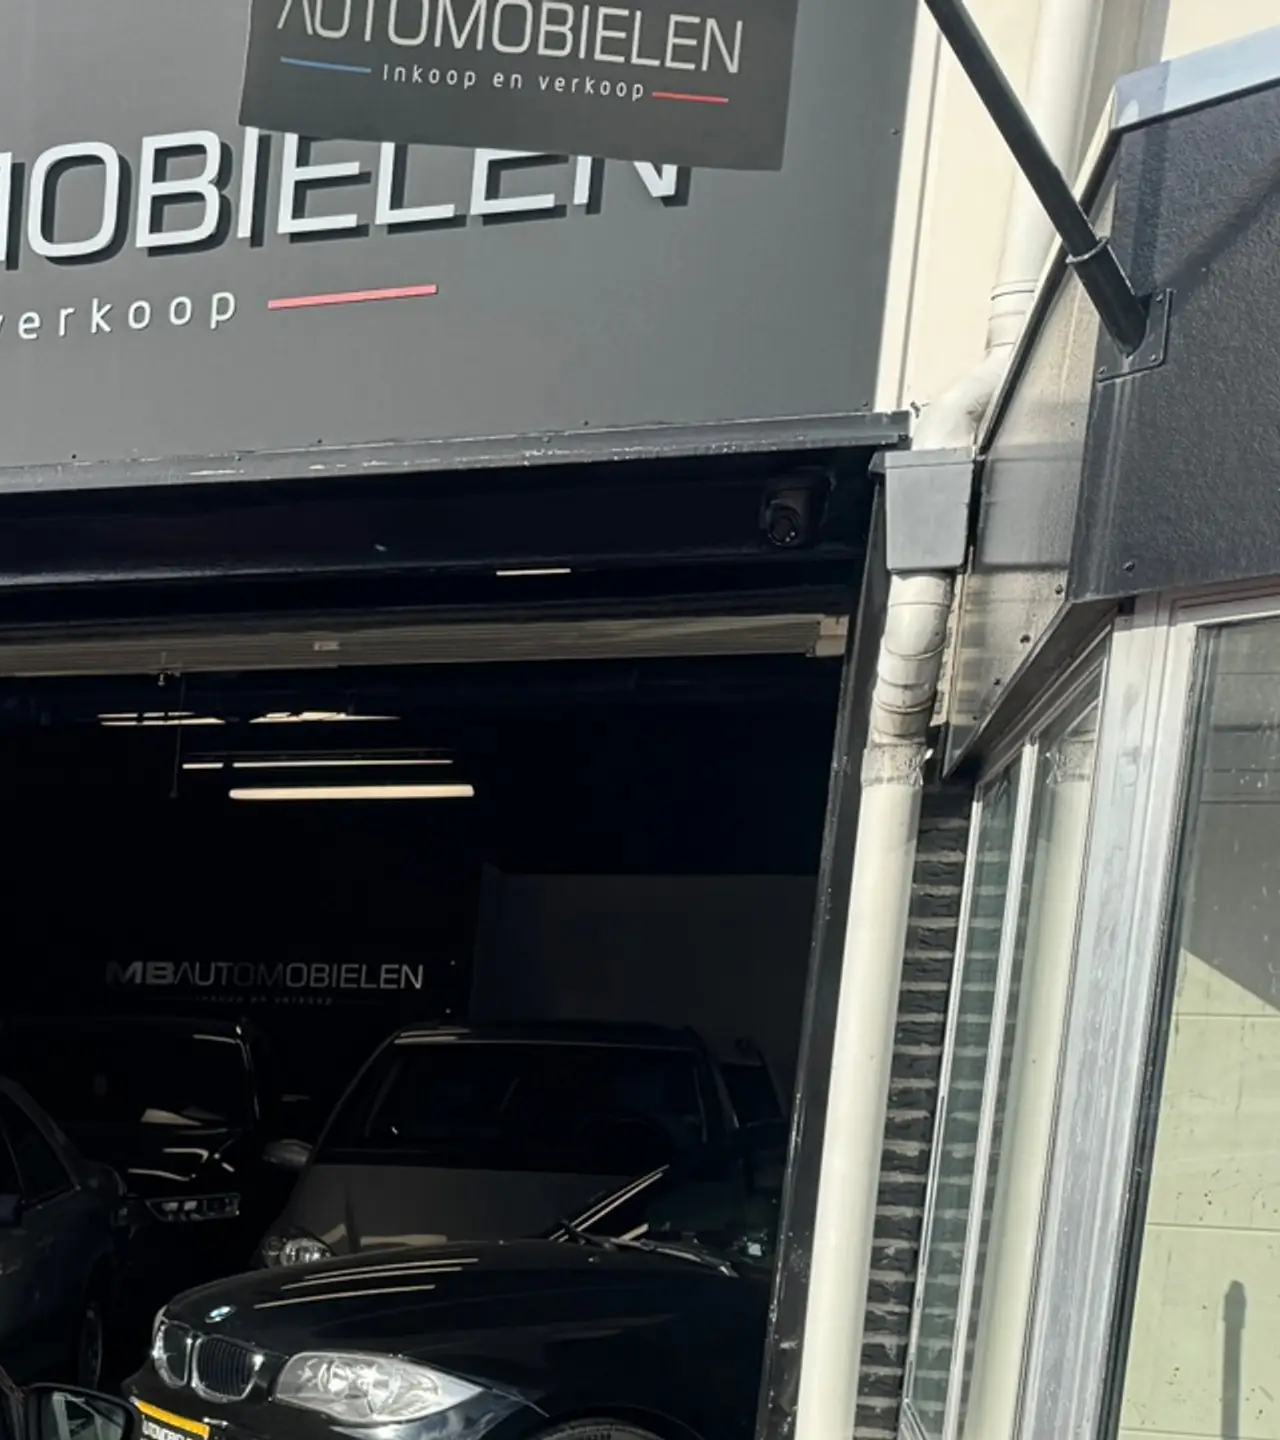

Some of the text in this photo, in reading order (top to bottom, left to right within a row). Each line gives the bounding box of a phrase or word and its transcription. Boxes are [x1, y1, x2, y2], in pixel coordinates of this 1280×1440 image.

[277, 0, 743, 74] AUTOMOBIELEN
[493, 71, 523, 89] en
[538, 74, 644, 101] verkoop
